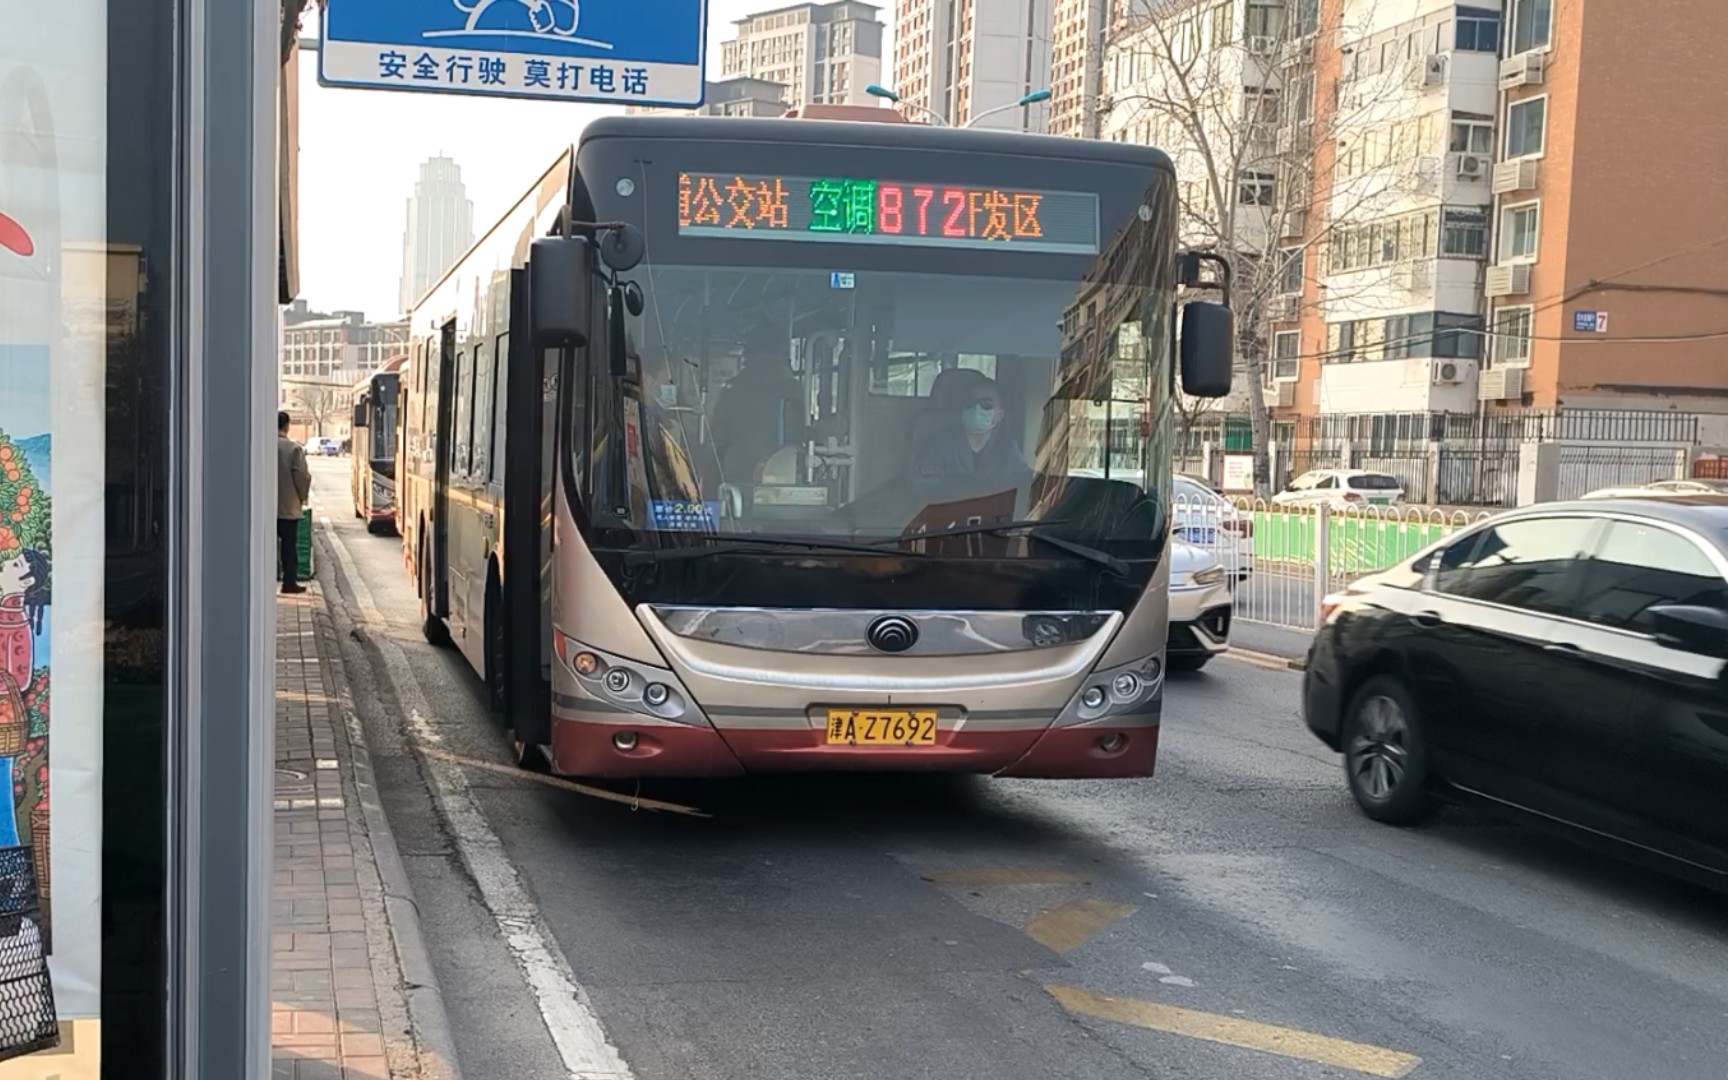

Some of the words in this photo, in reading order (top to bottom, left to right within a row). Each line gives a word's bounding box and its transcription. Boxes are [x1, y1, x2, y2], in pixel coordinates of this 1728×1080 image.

[379, 50, 507, 85] 安全行驶
[523, 60, 649, 95] 莫打电话
[879, 185, 966, 237] 872
[1598, 315, 1606, 329] 7
